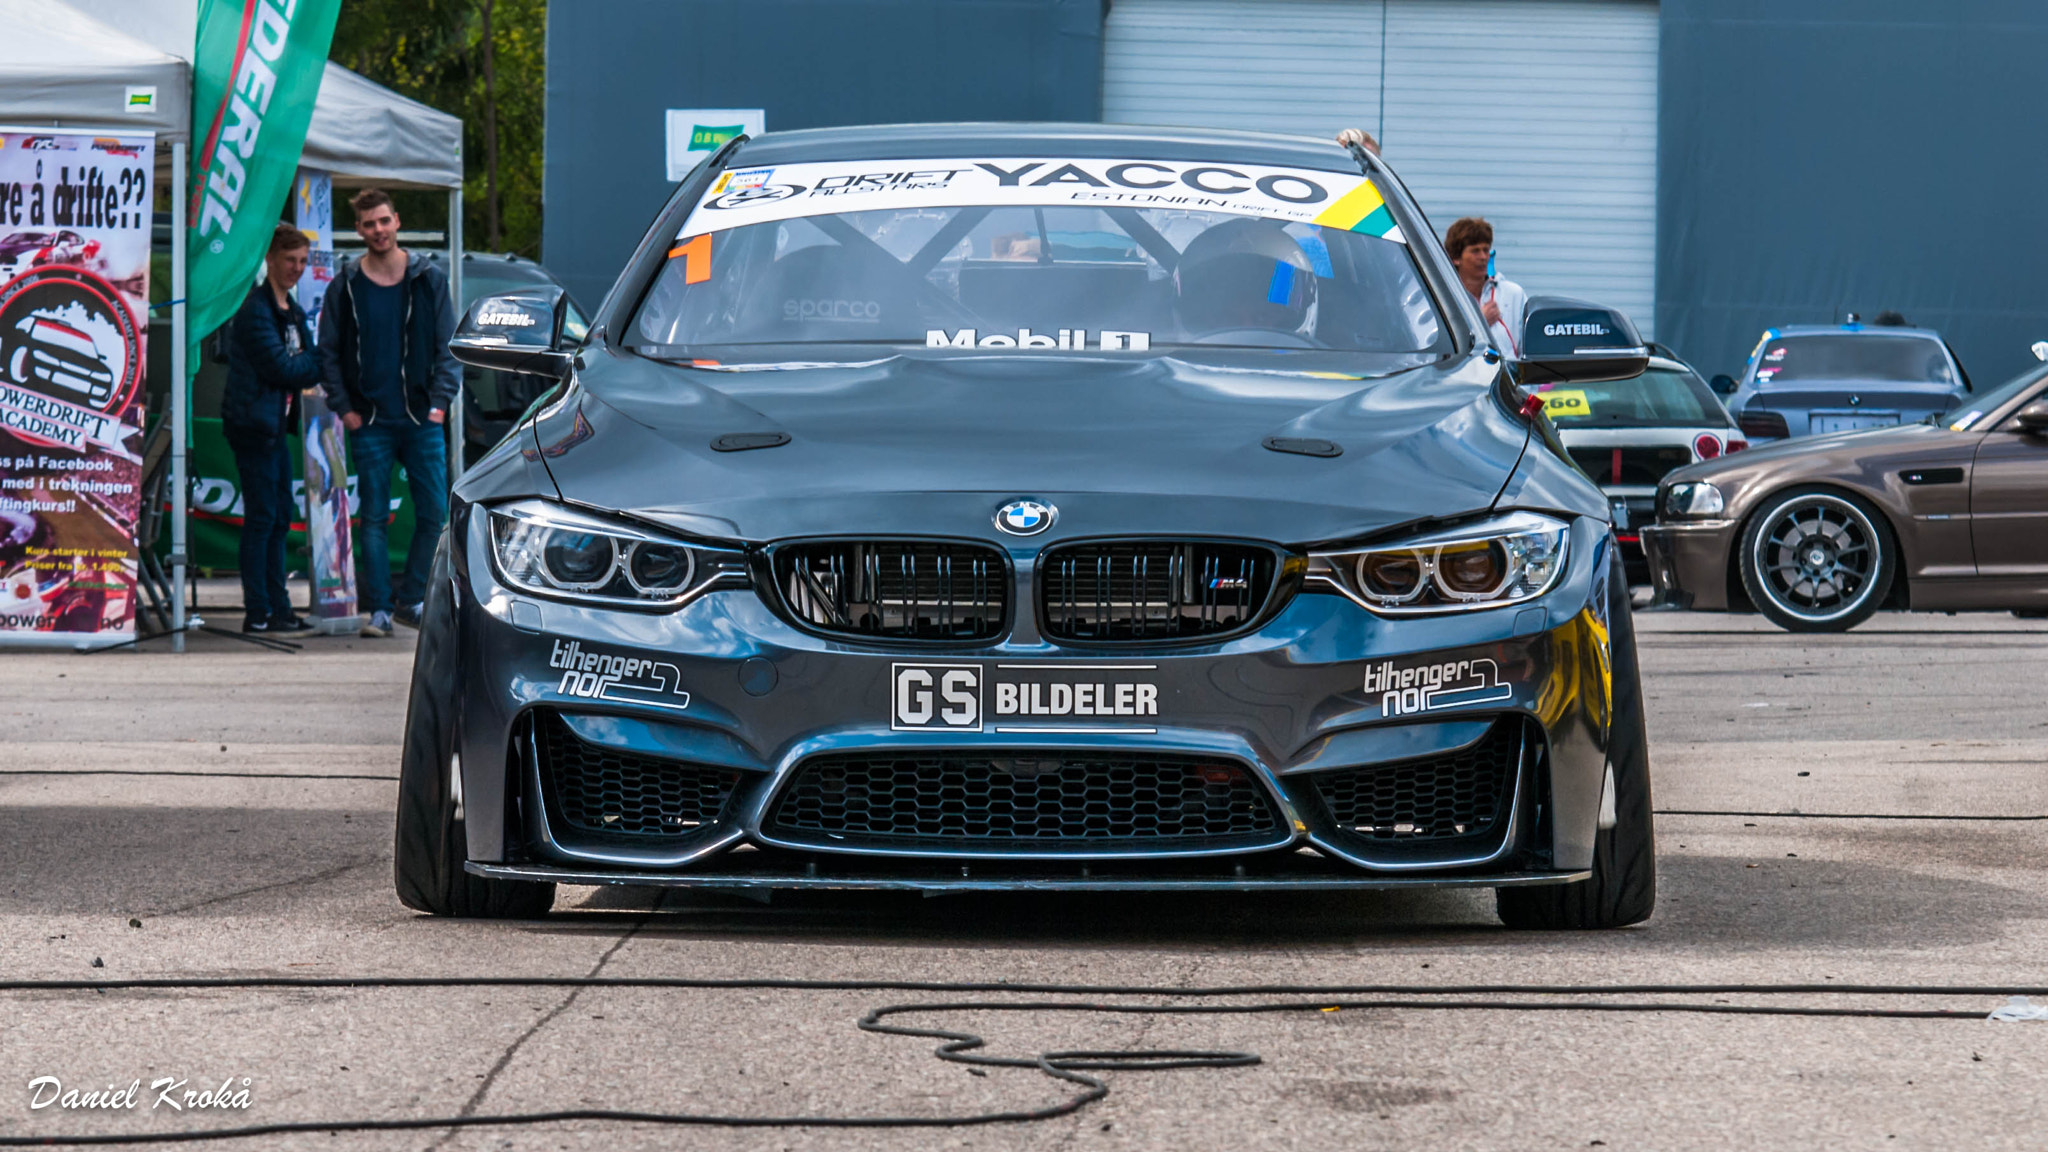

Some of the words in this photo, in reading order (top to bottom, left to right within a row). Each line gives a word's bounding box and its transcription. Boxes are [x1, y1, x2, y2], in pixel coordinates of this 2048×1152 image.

[814, 168, 974, 191] DRIFT
[974, 162, 1328, 204] YACCO
[30, 158, 44, 226] å
[53, 166, 145, 229] drifte??
[1070, 192, 1229, 208] ESTONIAN
[783, 298, 881, 323] sparco
[15, 453, 35, 471] på
[38, 456, 114, 472] Facebook
[2, 477, 35, 490] med
[39, 477, 45, 490] i
[48, 478, 133, 496] trekningen
[97, 549, 128, 558] vinter
[549, 639, 652, 682] tilhenger
[1364, 659, 1470, 693] tilhenger
[897, 668, 977, 725] GS
[995, 683, 1158, 715] BILDELER
